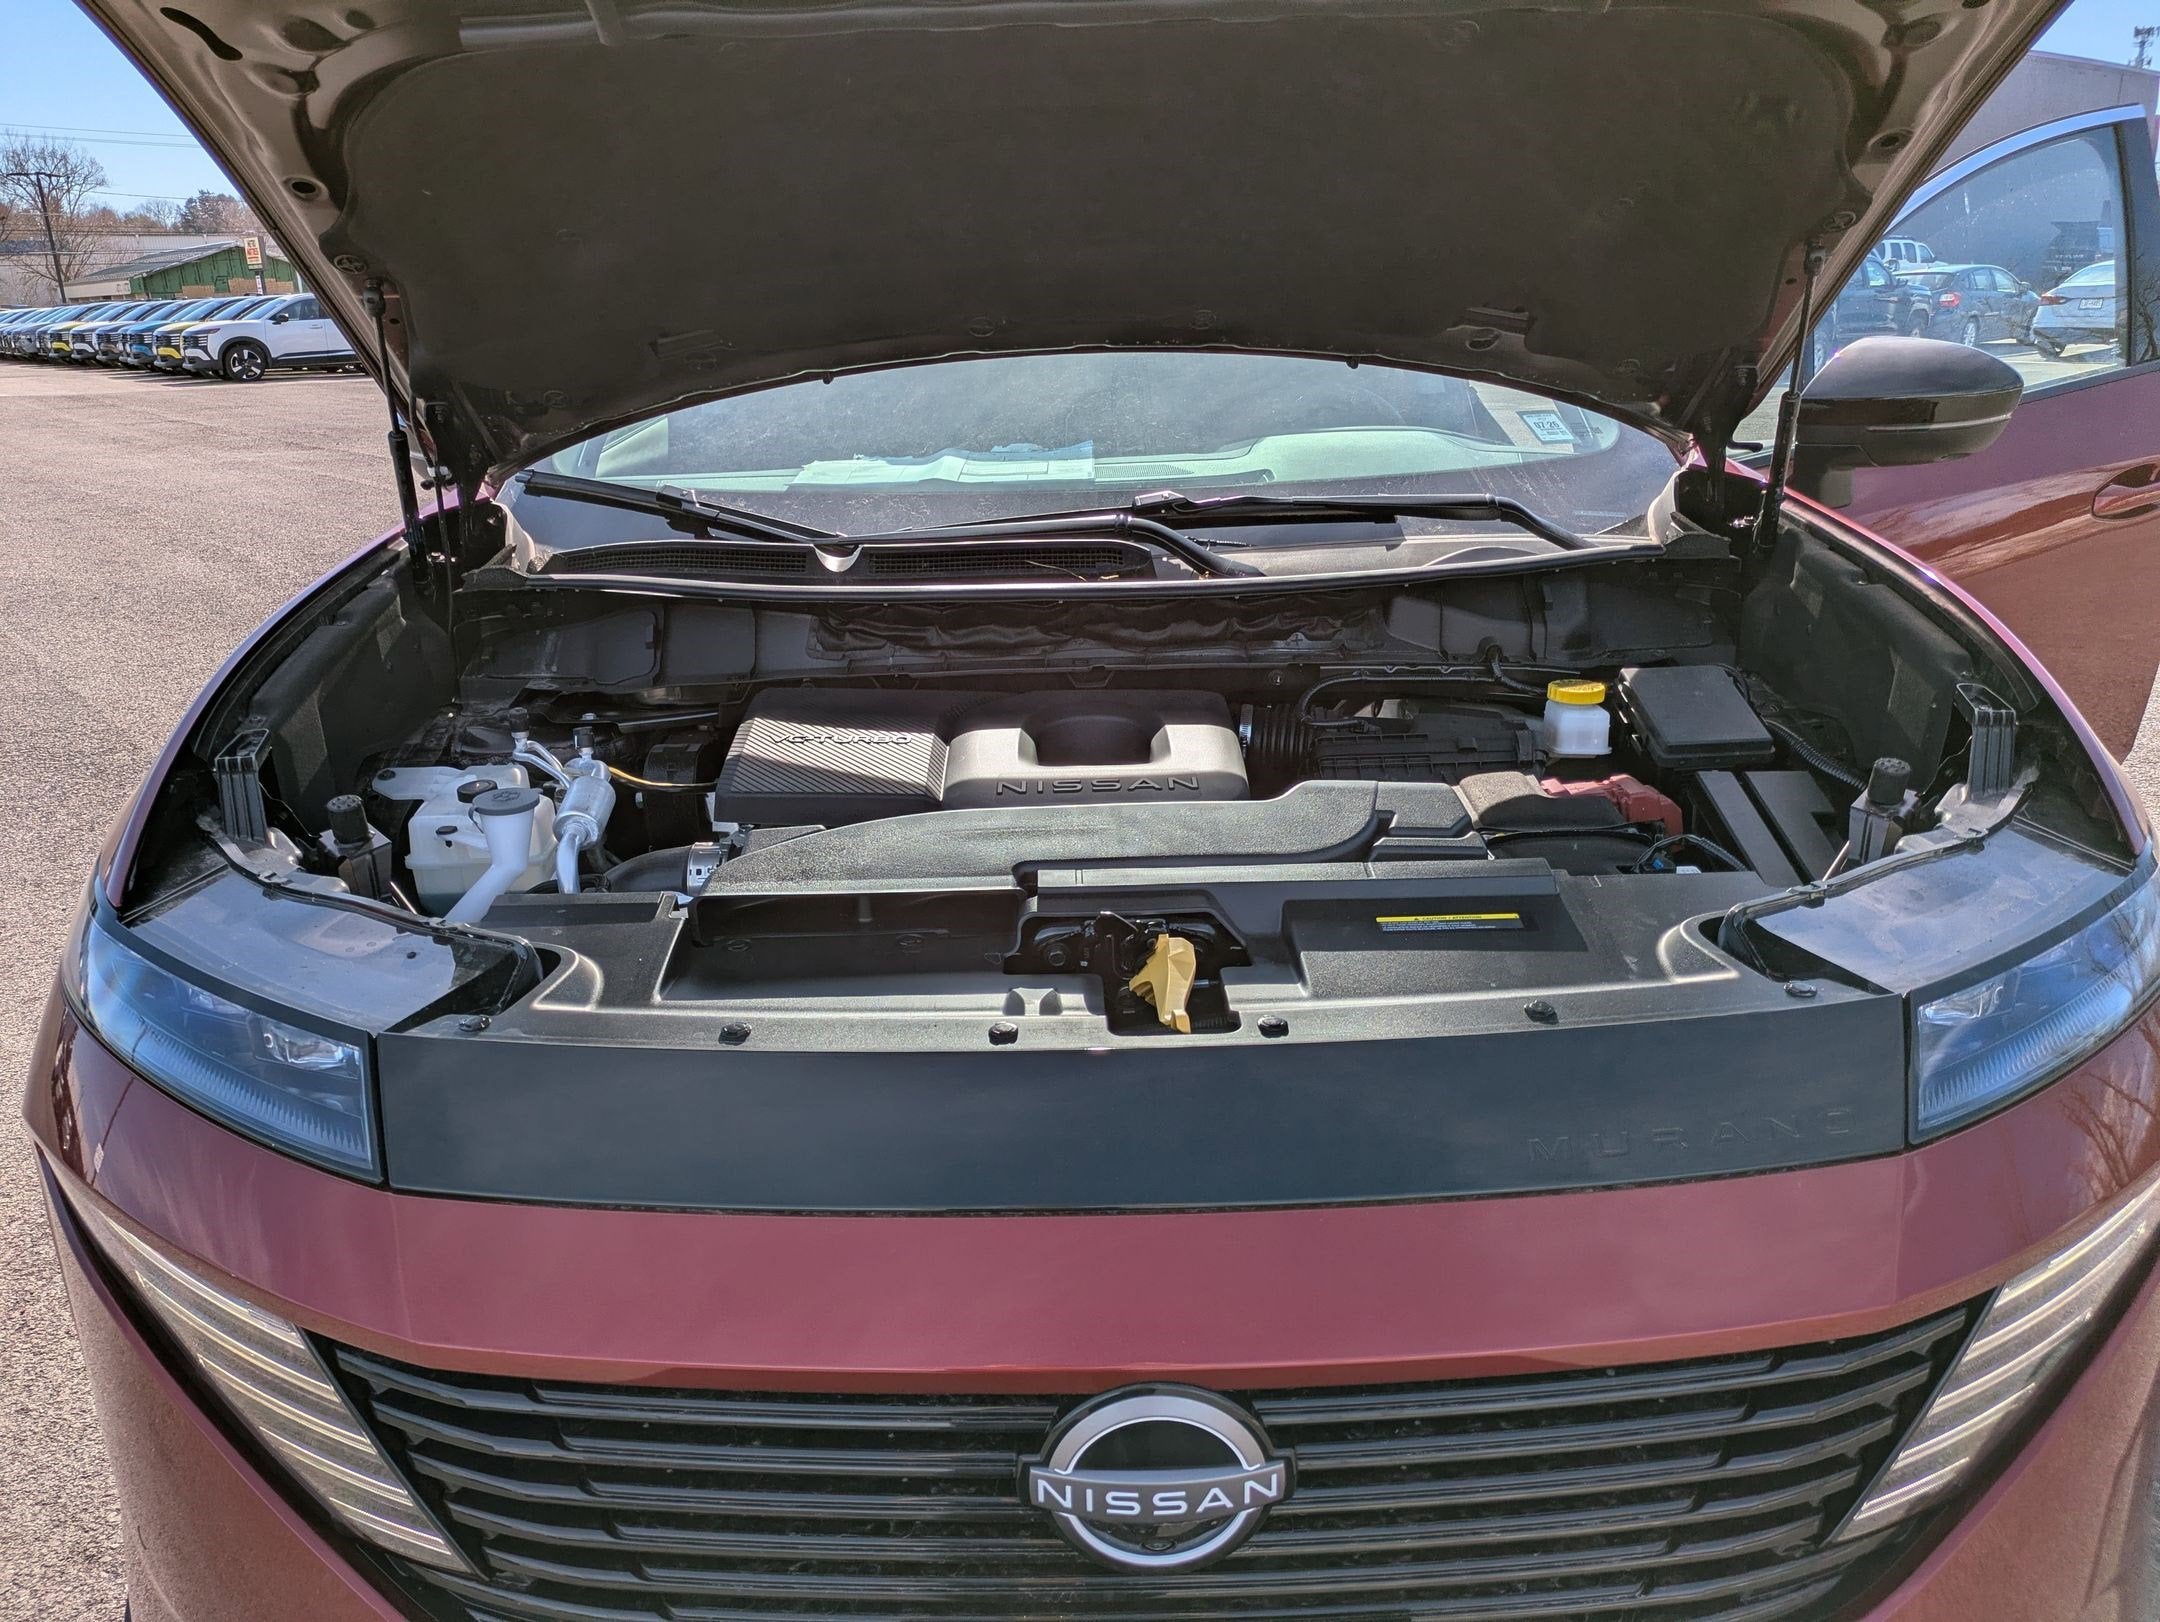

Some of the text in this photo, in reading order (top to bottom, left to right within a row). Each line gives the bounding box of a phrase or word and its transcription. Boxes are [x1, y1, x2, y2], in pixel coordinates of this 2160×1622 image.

[769, 733, 912, 744] VC-TURBO
[996, 776, 1199, 795] NISSAN
[1527, 1107, 1857, 1161] MURANO
[1037, 1473, 1278, 1516] NISSAN
